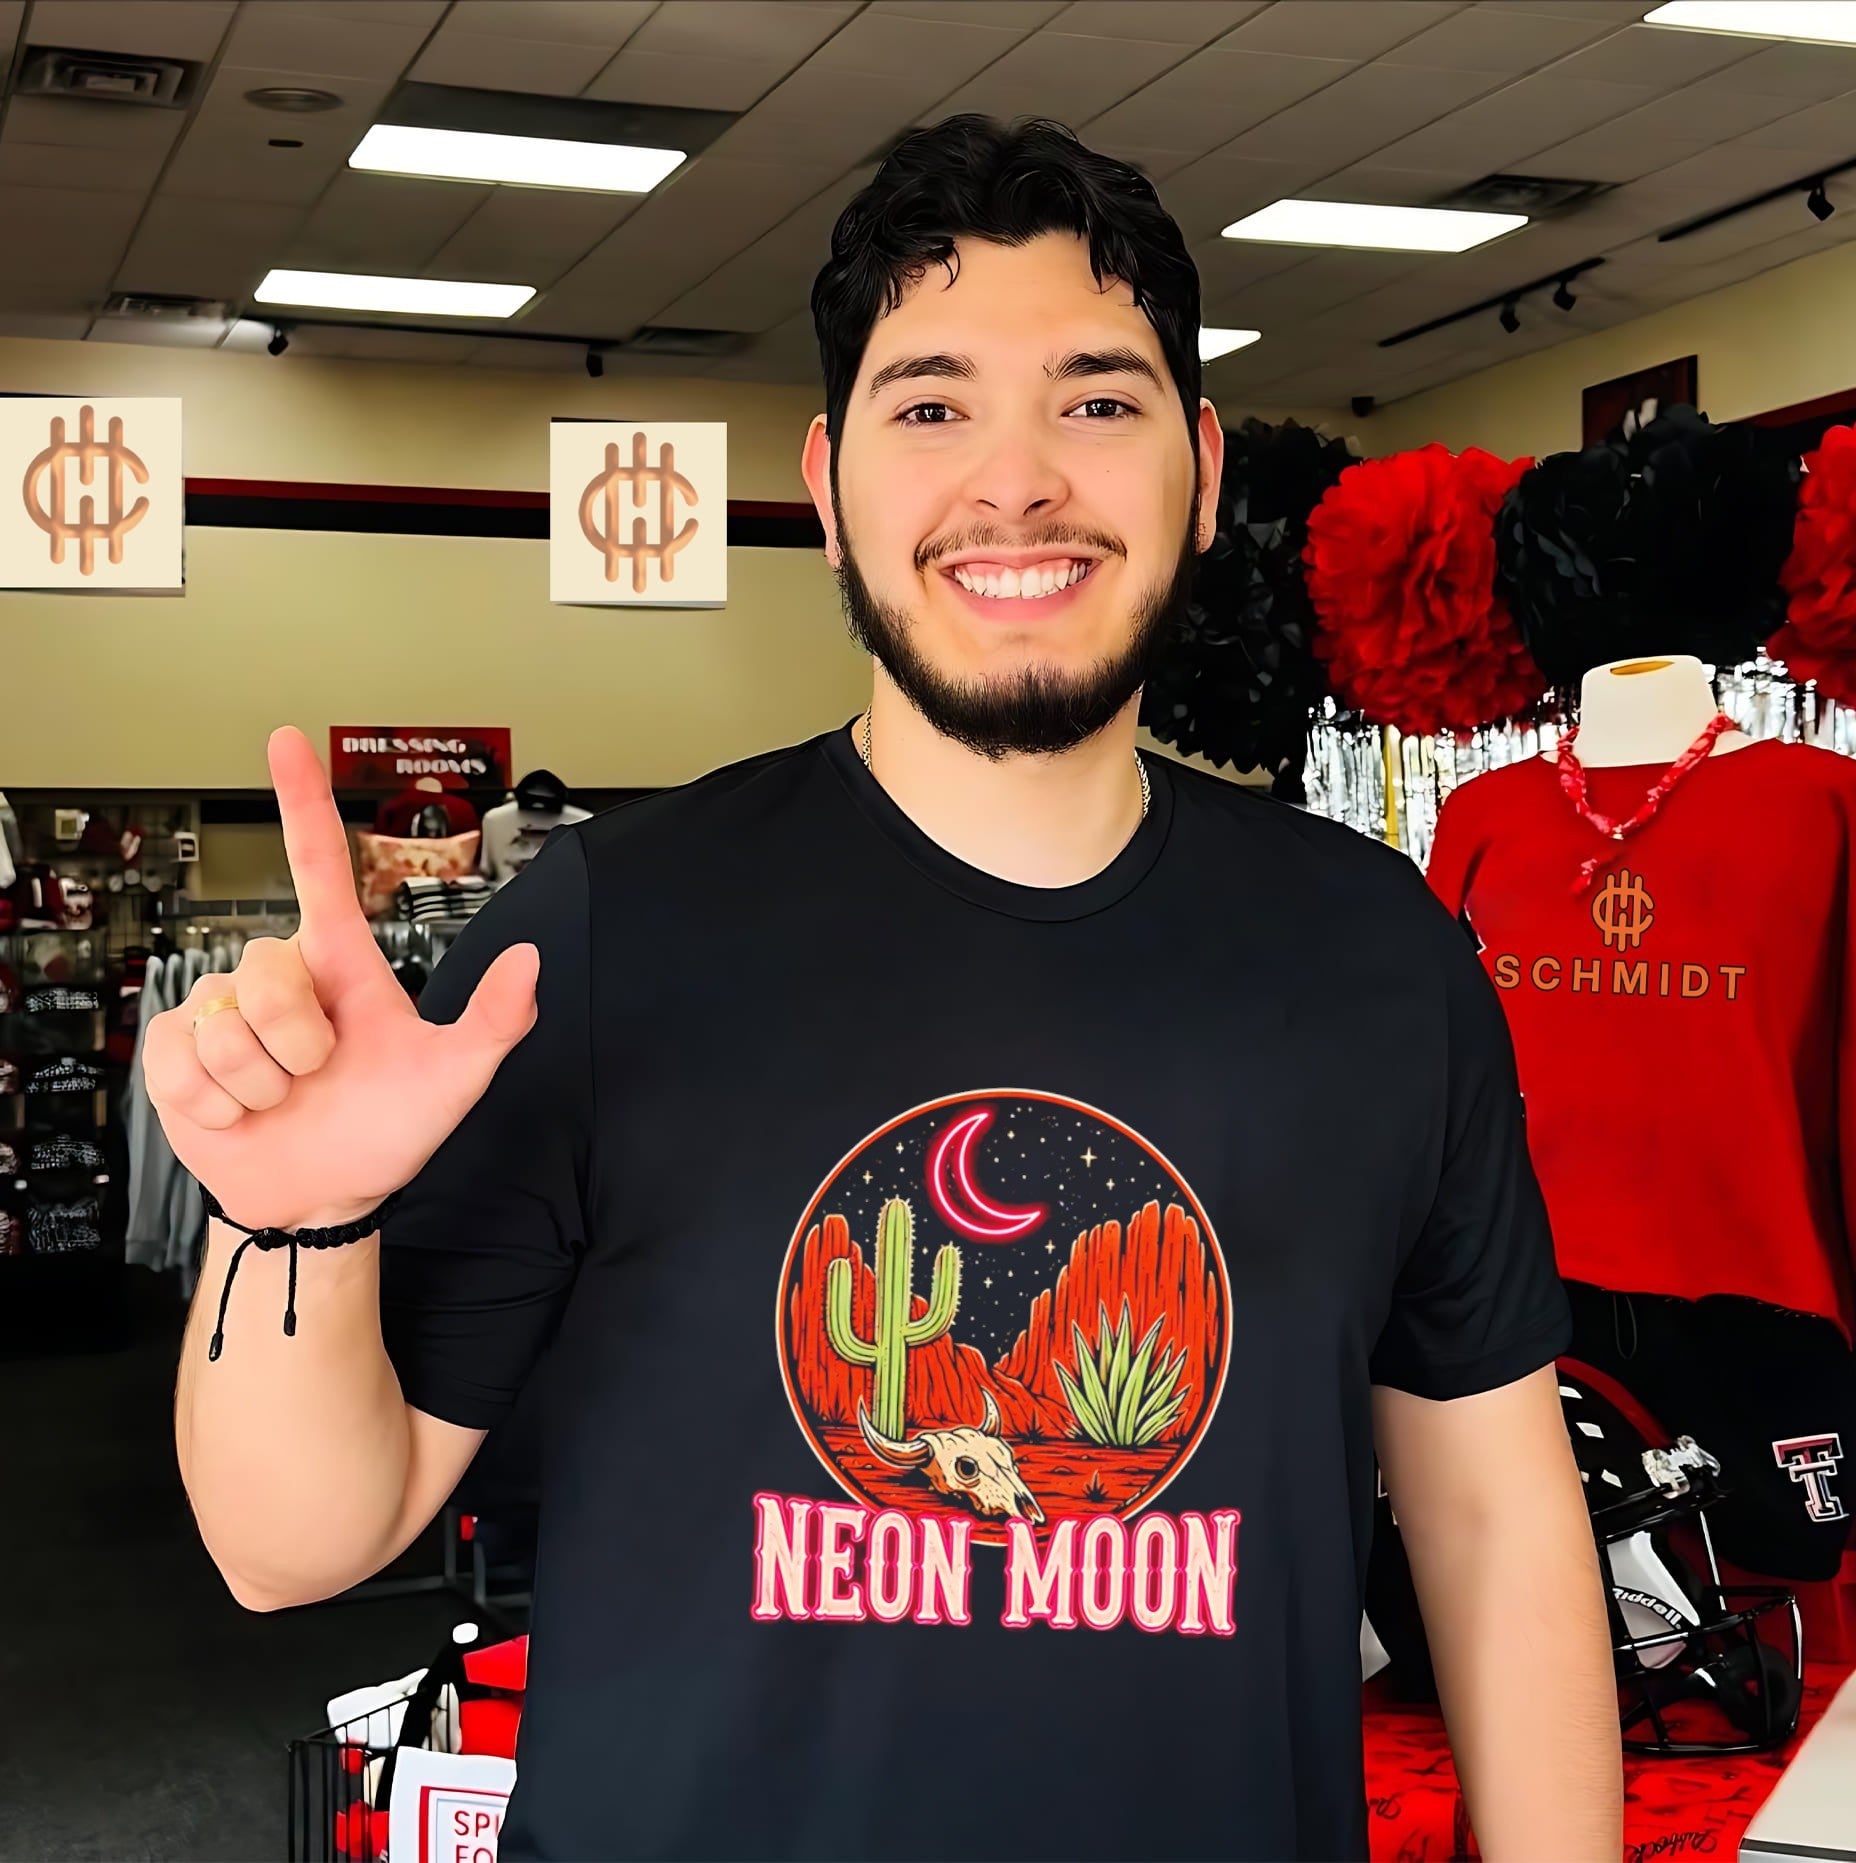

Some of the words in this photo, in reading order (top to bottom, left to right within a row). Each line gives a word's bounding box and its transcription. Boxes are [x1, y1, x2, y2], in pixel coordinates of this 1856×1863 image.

[342, 737, 467, 754] DRESSING
[396, 758, 487, 775] ROOMS
[1494, 953, 1747, 1001] SCHMIDT
[752, 1491, 973, 1628] NEON
[1001, 1508, 1242, 1639] MOON
